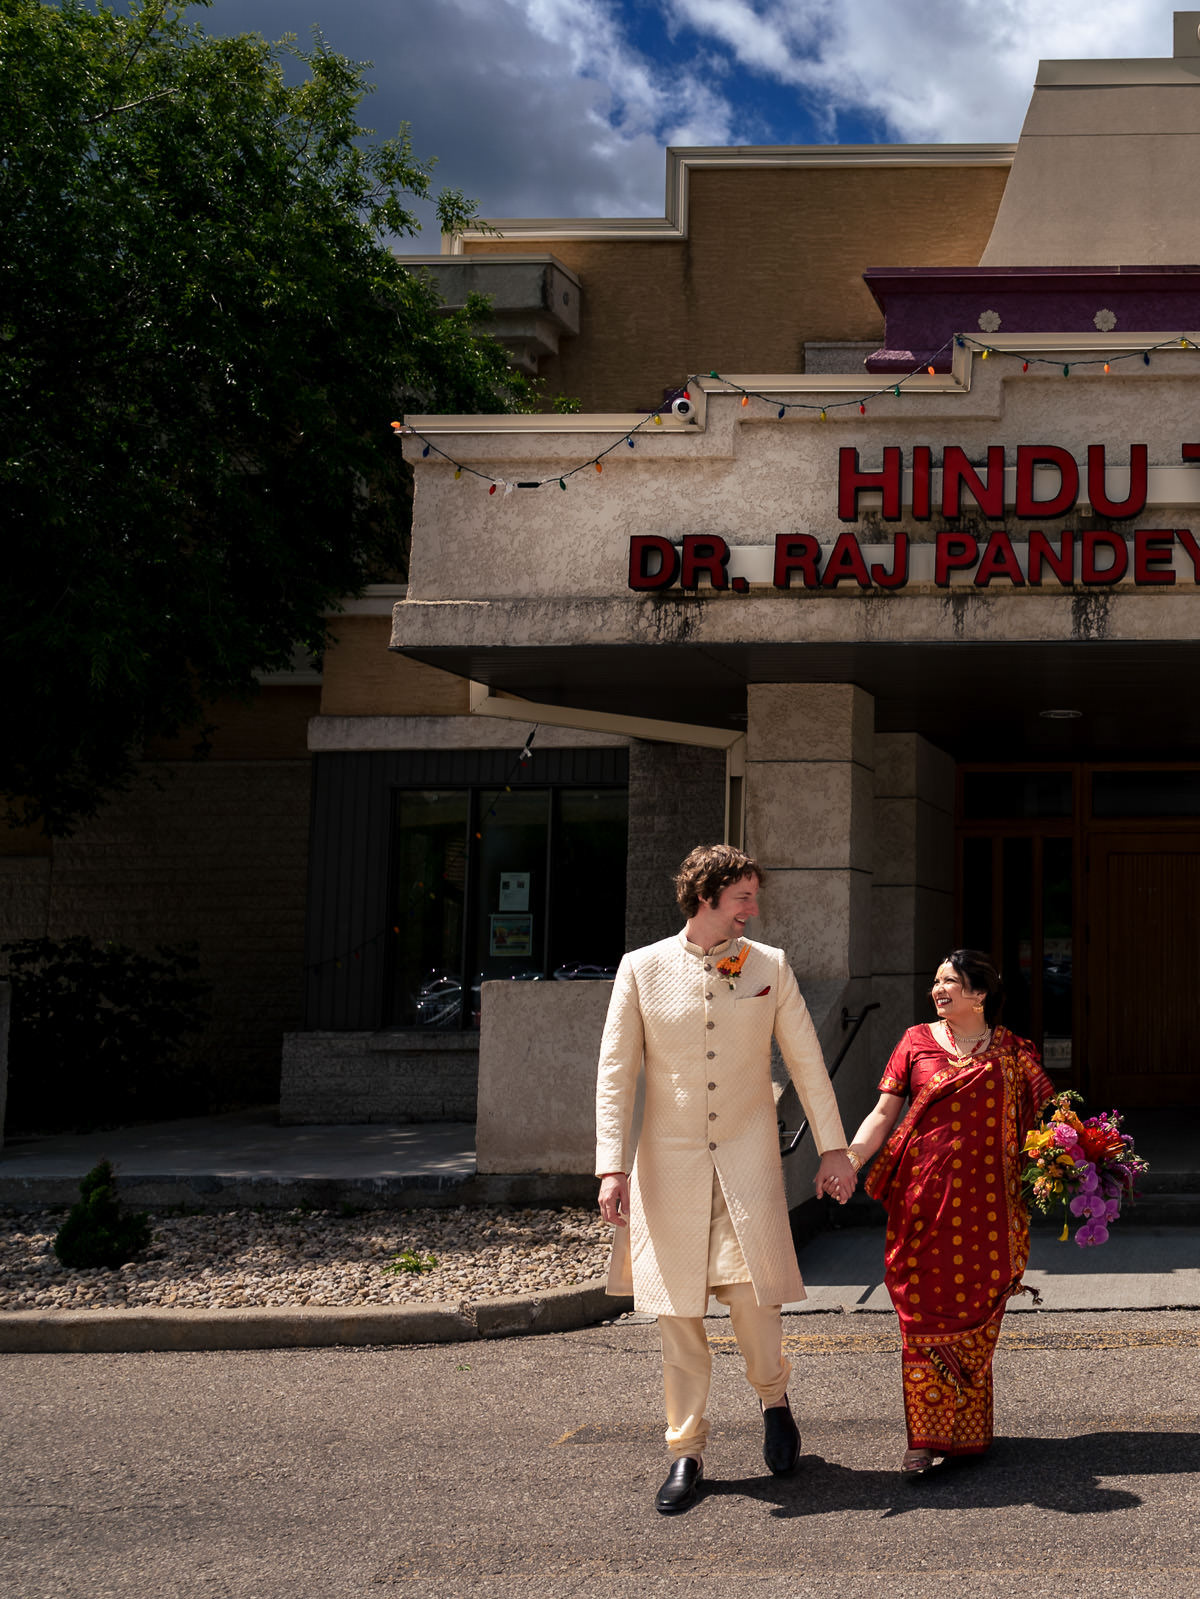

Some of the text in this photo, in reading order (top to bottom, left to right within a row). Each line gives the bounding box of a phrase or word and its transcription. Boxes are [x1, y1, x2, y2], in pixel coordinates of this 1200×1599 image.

[838, 443, 1148, 522] HINDU
[628, 533, 750, 593] DR.
[773, 531, 909, 589] RAJ
